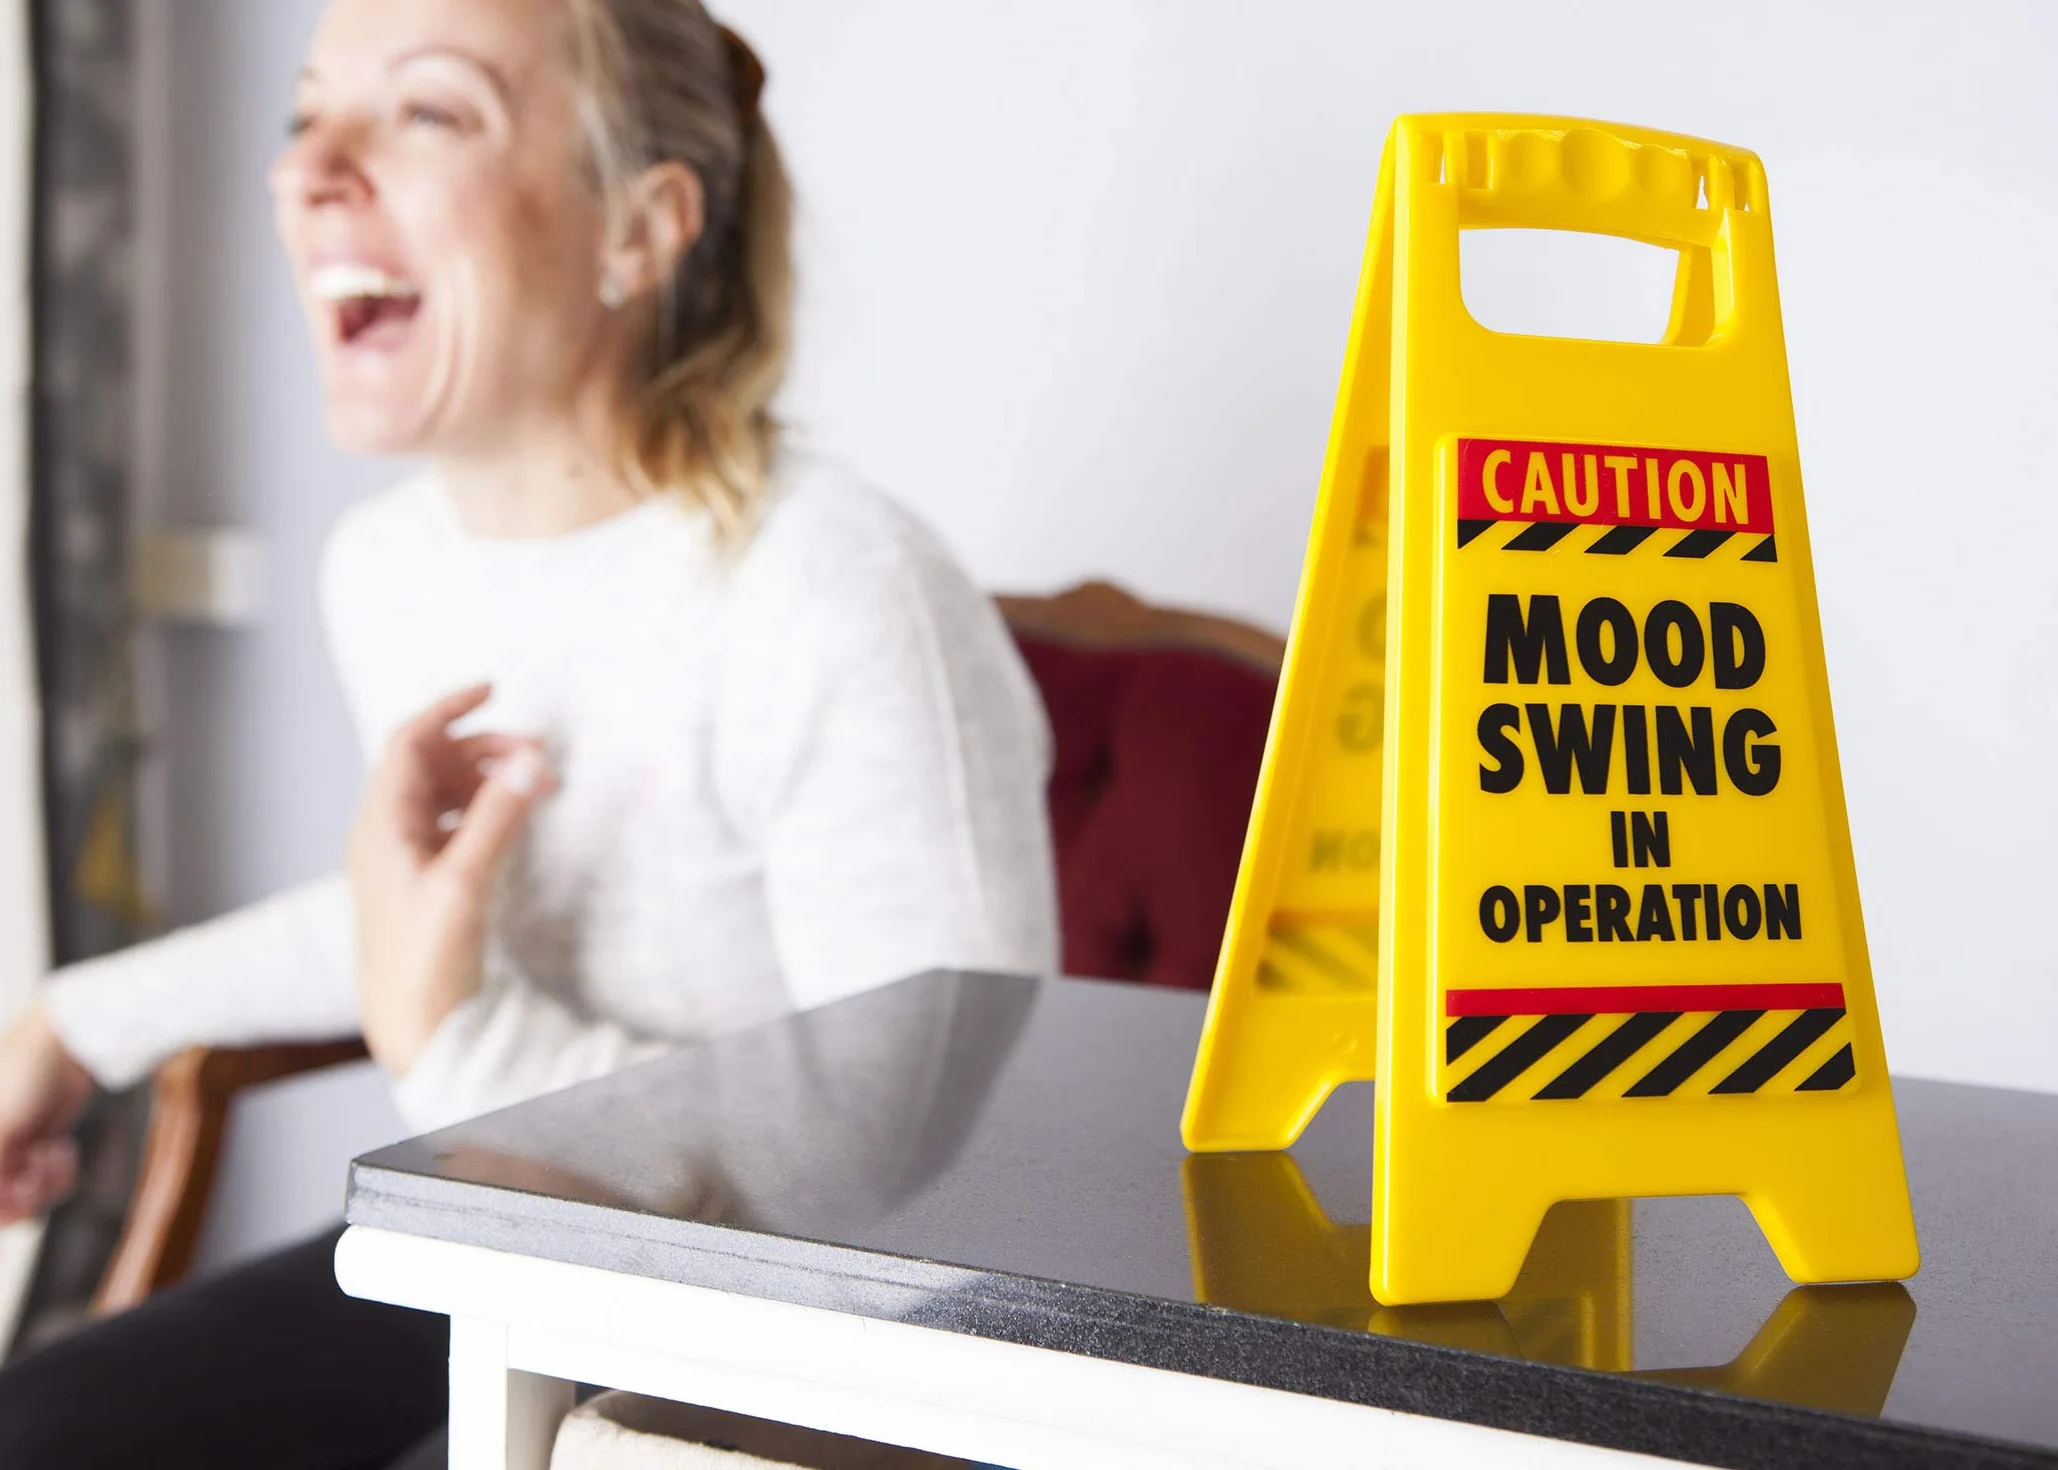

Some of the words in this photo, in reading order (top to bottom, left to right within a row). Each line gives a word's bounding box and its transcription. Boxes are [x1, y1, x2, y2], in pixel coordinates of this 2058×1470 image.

[1482, 450, 1749, 525] CAUTION
[1483, 594, 1766, 690] MOOD
[1477, 703, 1782, 797] SWING
[1610, 811, 1671, 868] IN
[1479, 884, 1803, 943] OPERATION
